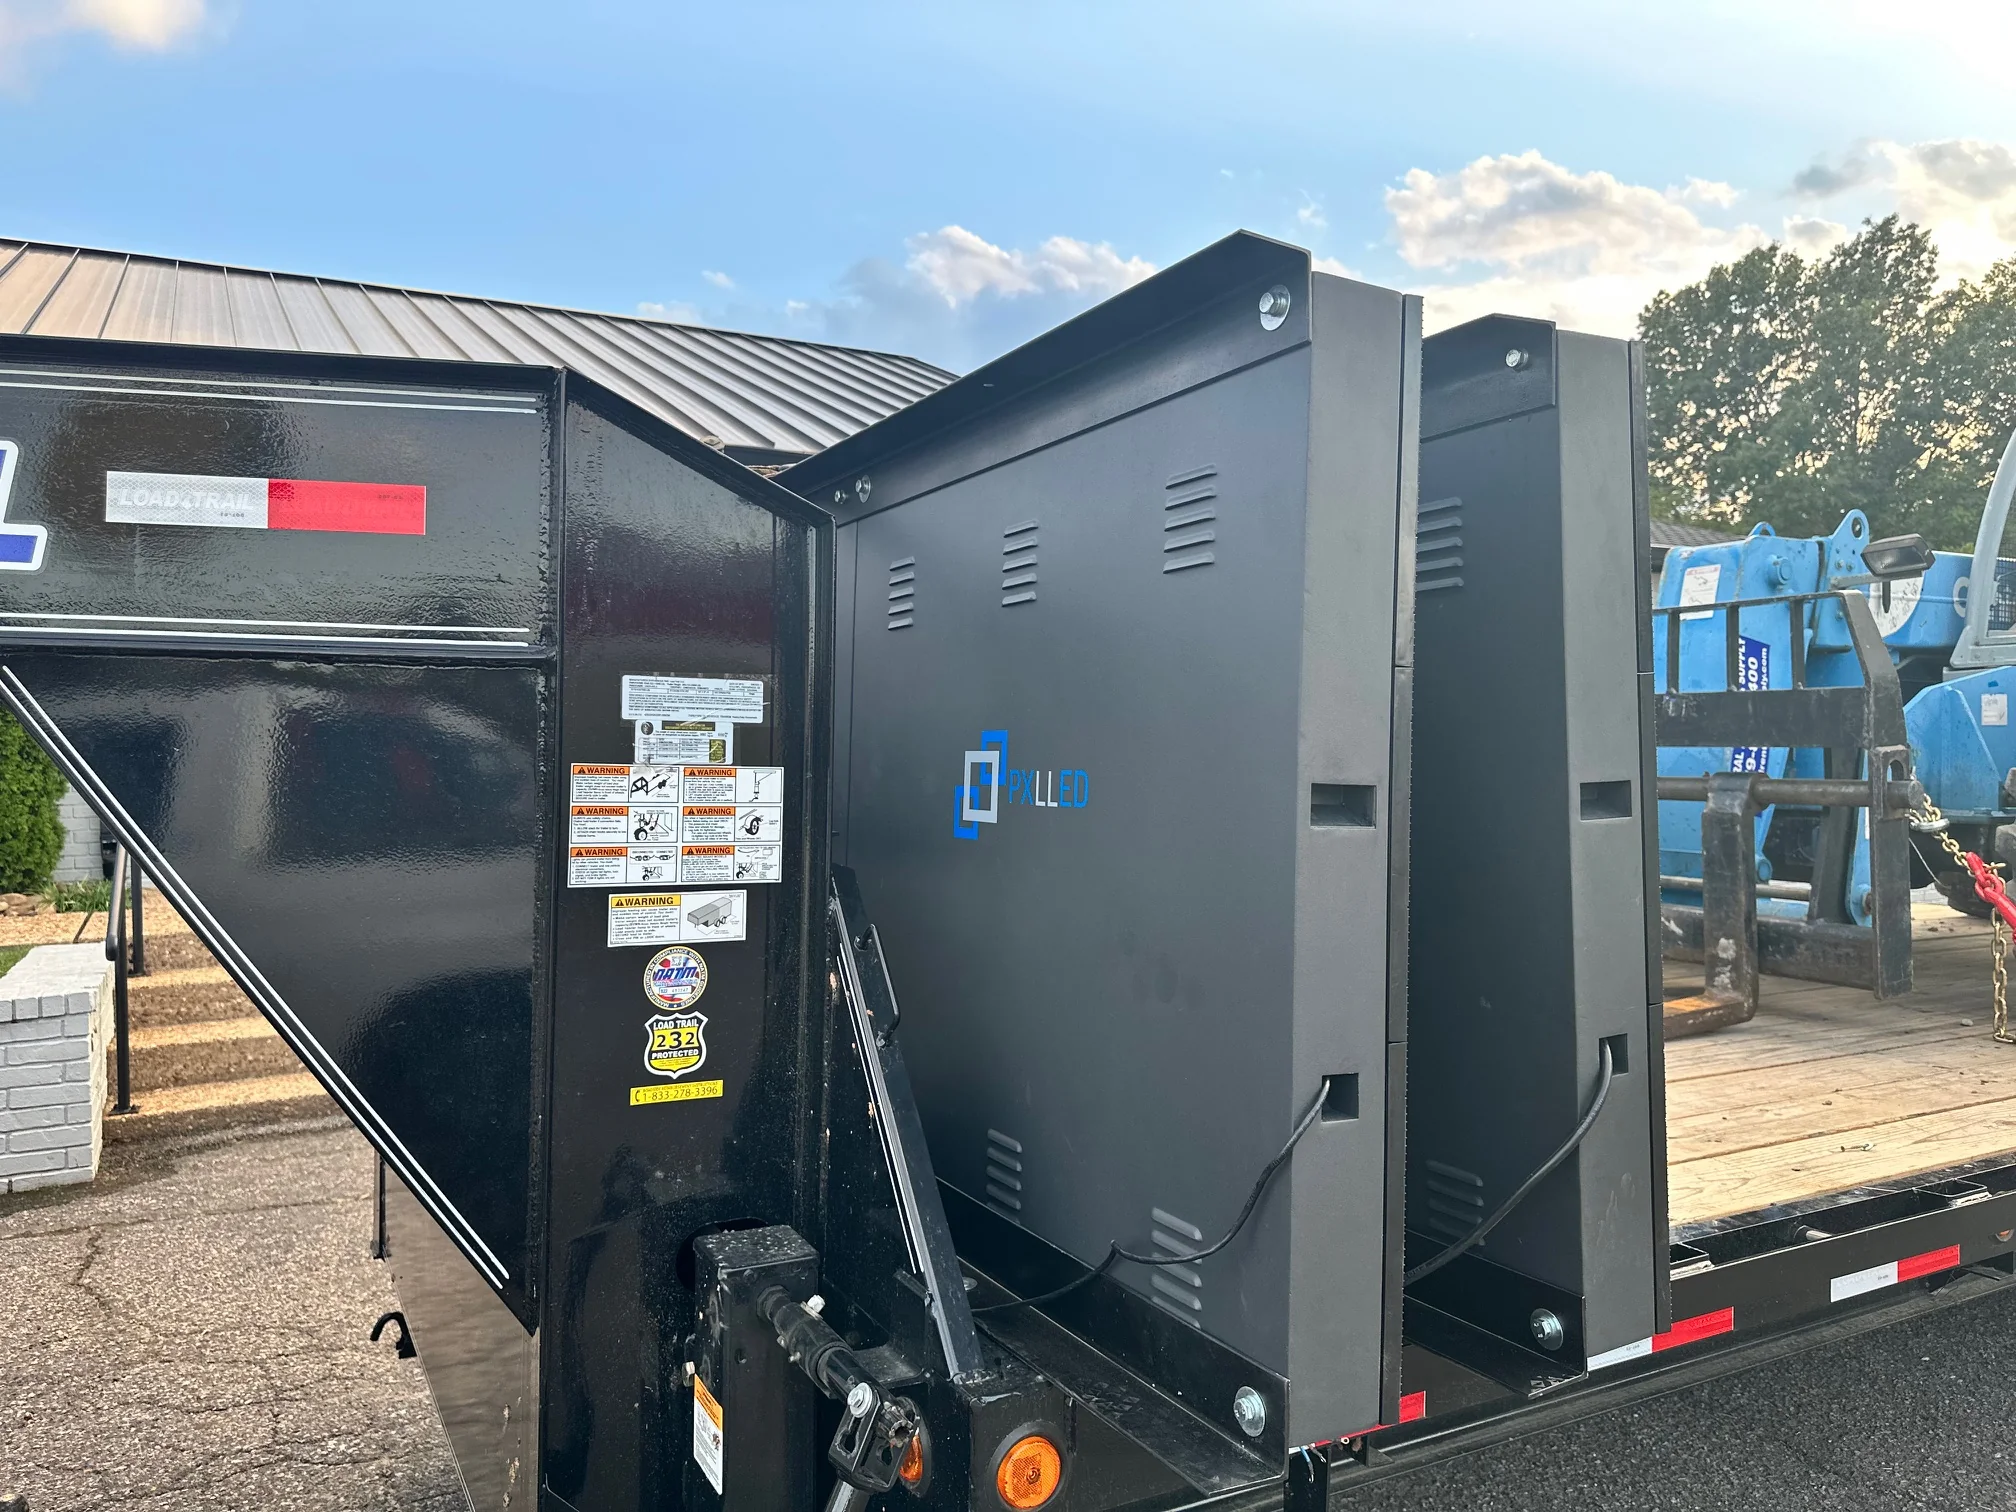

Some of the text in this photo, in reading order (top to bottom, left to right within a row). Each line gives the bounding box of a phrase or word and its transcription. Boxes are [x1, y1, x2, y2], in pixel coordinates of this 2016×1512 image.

[119, 487, 254, 511] LOAD TRAIL
[1008, 769, 1089, 809] PXLLED
[585, 848, 623, 856] WARNING
[625, 896, 674, 906] WARNING
[653, 1018, 699, 1030] LOAD TRAIL
[656, 1031, 695, 1049] 232
[652, 1049, 699, 1060] PROTECTED
[643, 1086, 718, 1102] 1-833-278-3396
